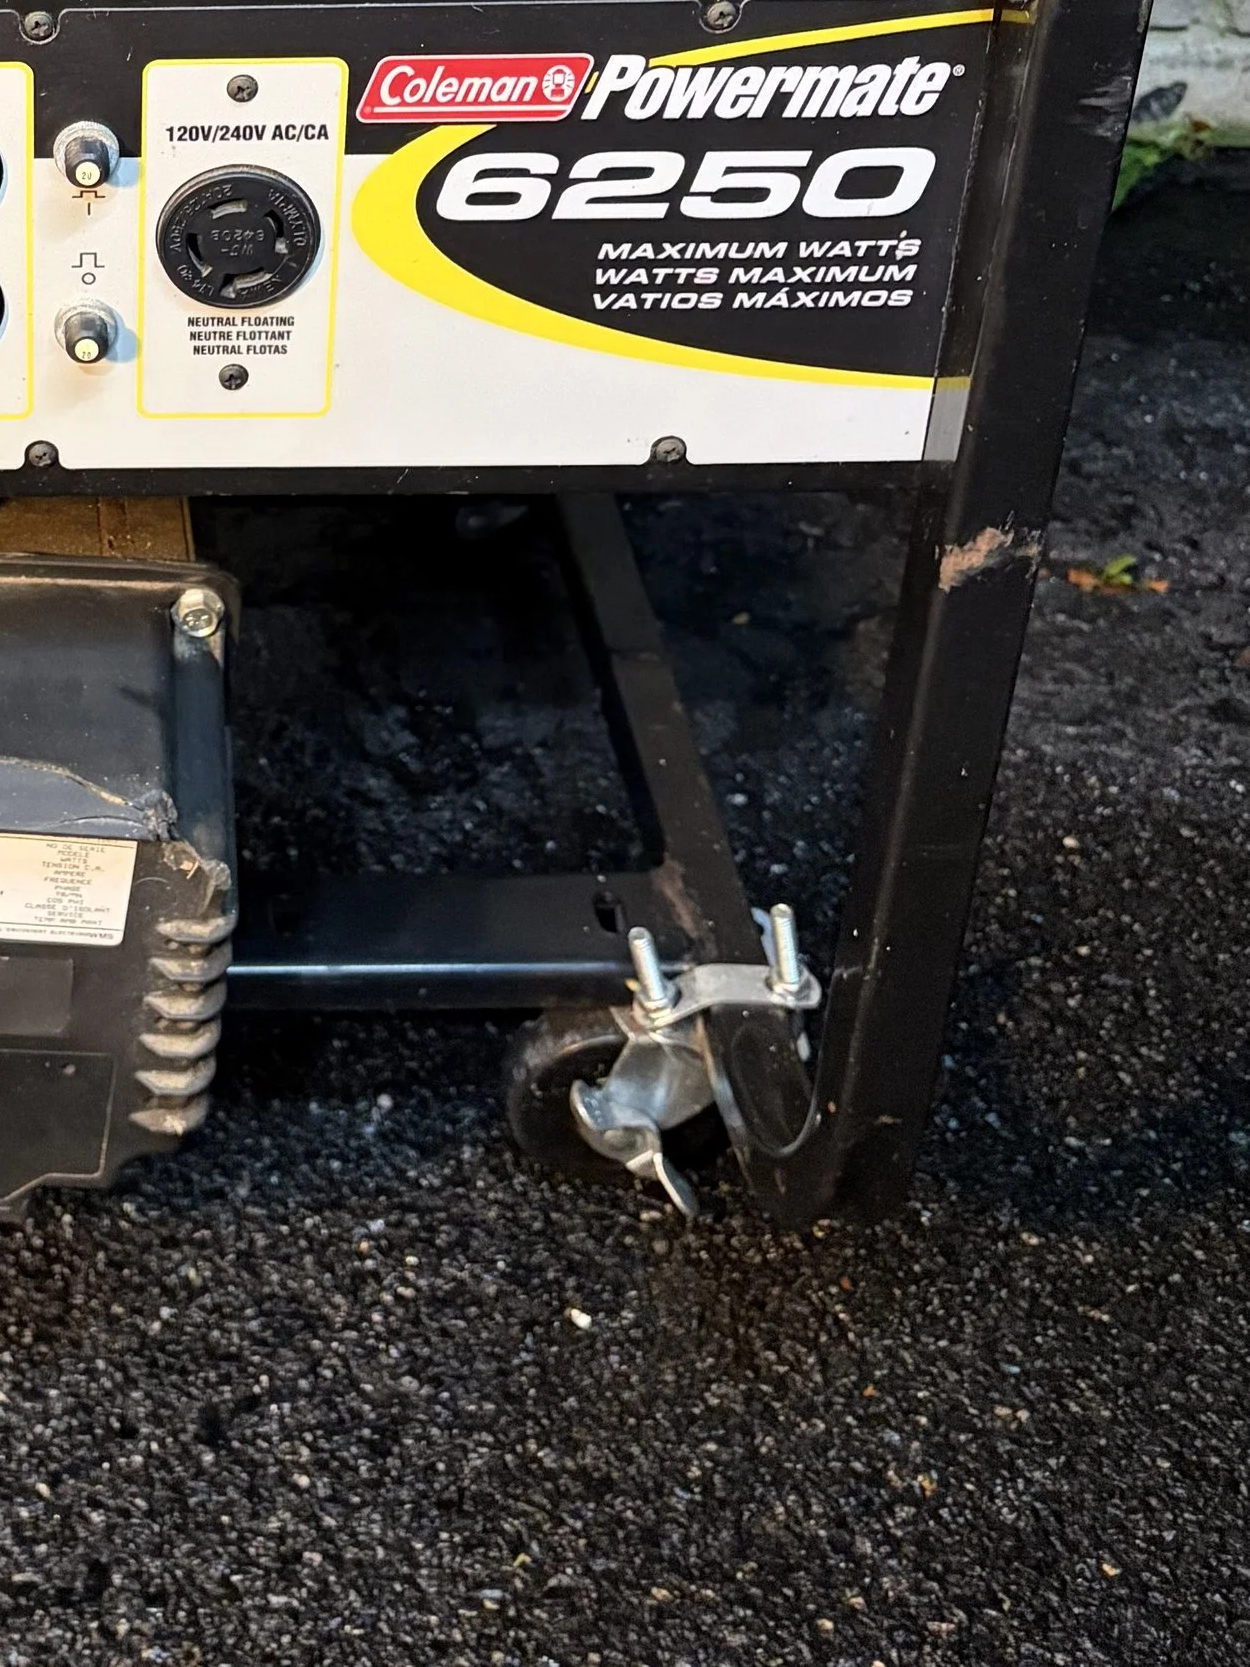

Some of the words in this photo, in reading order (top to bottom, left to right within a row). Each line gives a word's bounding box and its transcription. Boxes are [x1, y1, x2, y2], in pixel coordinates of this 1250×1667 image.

[380, 64, 537, 106] Coleman
[166, 125, 266, 143] 120V/240V
[272, 124, 329, 142] AC/CA
[436, 147, 937, 221] 6250
[597, 241, 789, 259] MAXIMUM
[799, 238, 921, 258] WATTS
[594, 267, 719, 286] WATTS
[727, 265, 917, 283] MAXIMUM
[592, 293, 723, 311] VATIOS
[732, 287, 913, 308] MÁXIMOS
[188, 317, 238, 327] NEUTRAL
[241, 316, 294, 326] FLOATING
[190, 331, 232, 341] NEUTRE
[236, 331, 291, 340] FLOTTANT
[193, 345, 243, 355] NEUTRAL
[247, 345, 287, 354] FLOTAS
[42, 861, 80, 869] TENSION
[44, 877, 92, 885] FREQUENCE
